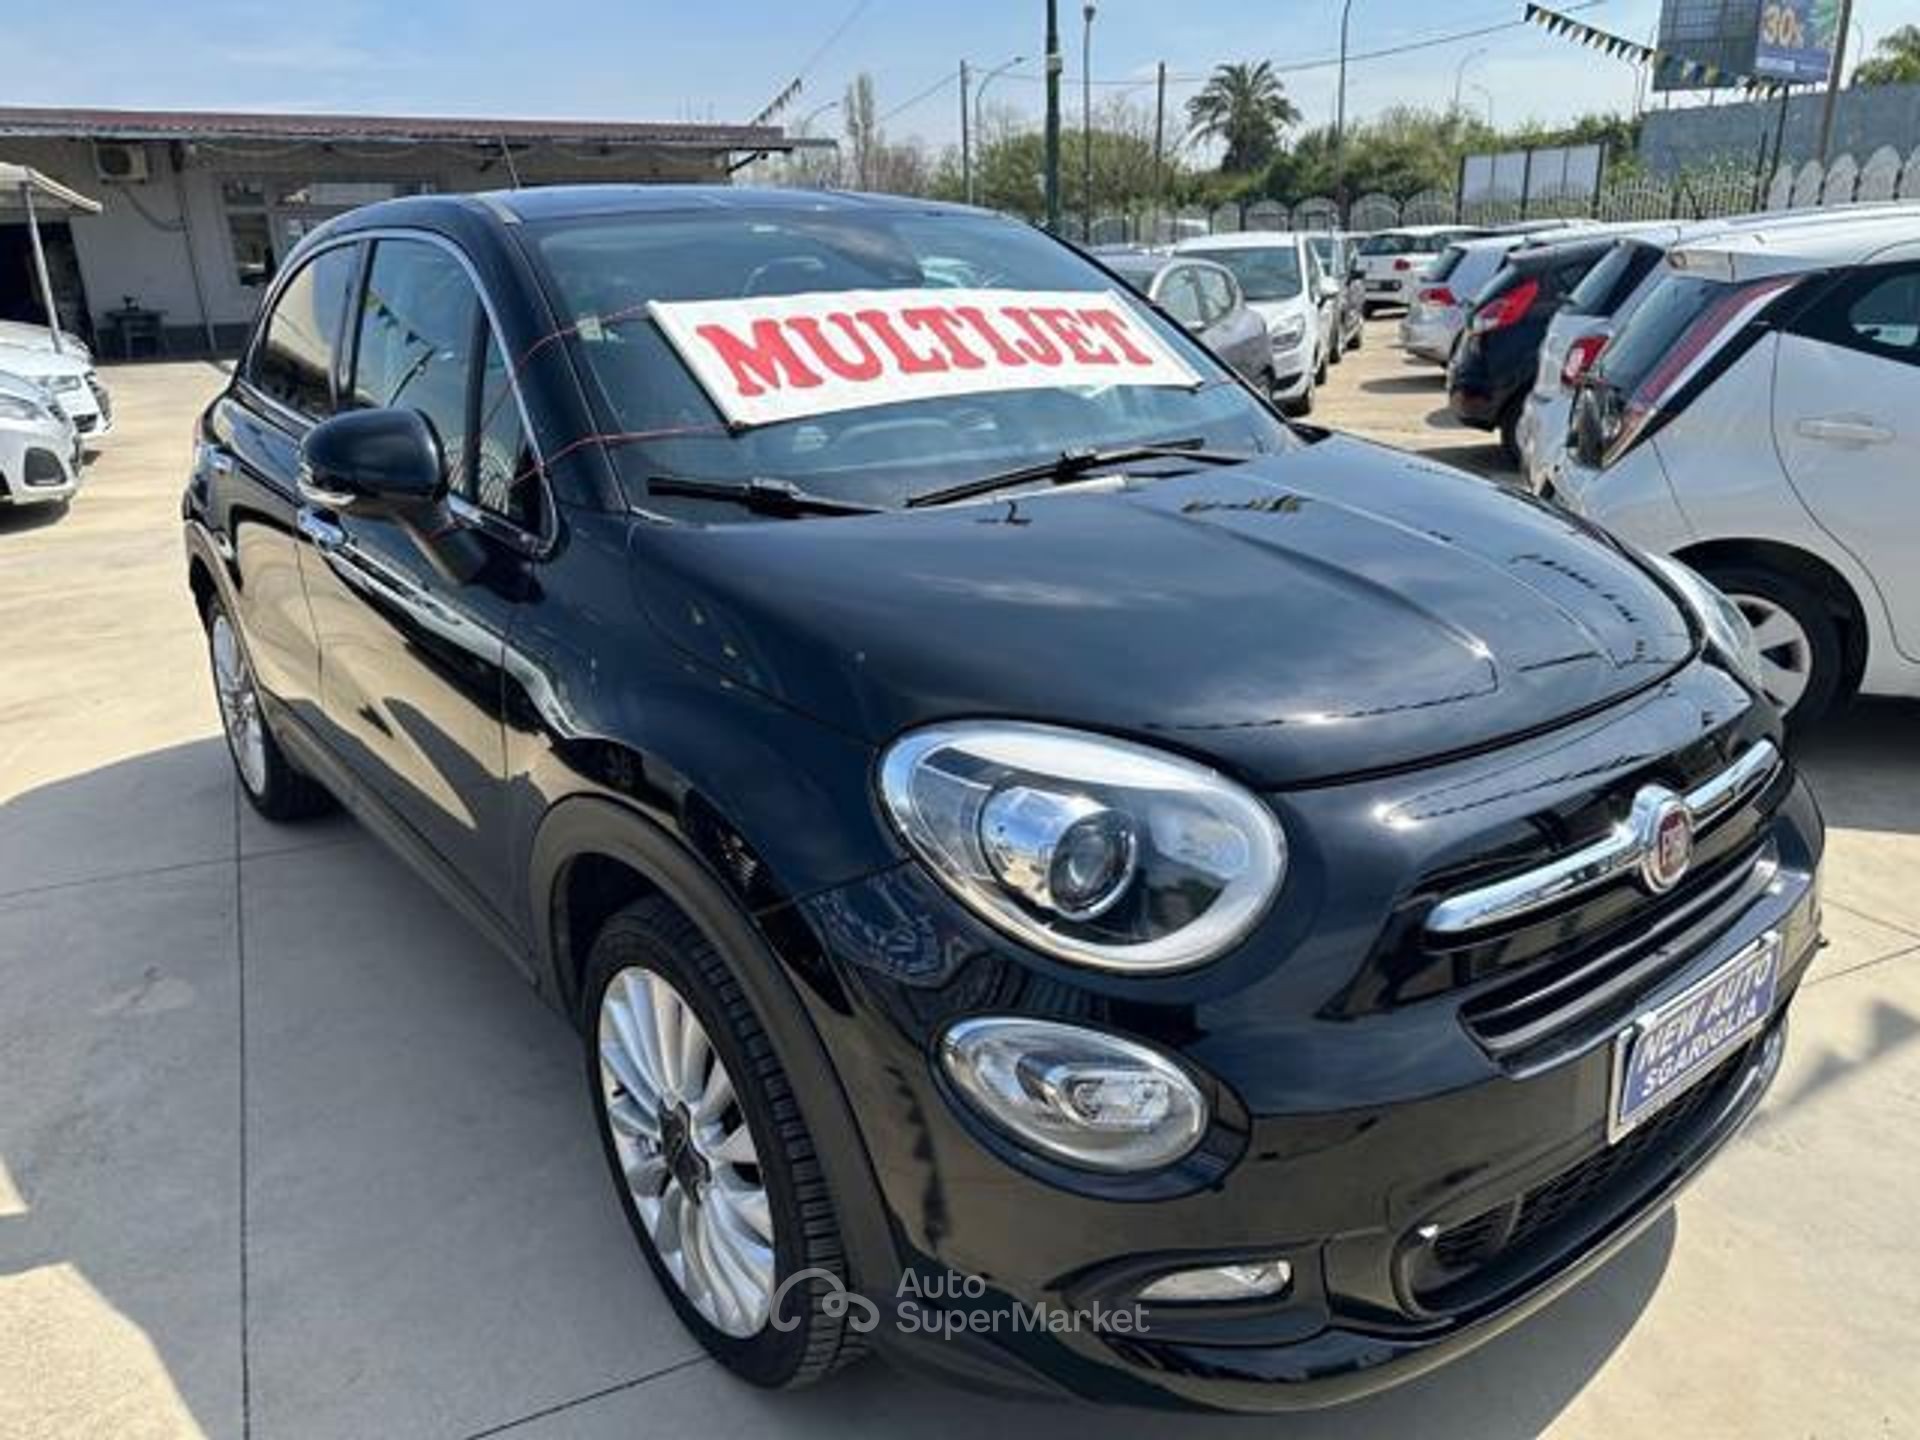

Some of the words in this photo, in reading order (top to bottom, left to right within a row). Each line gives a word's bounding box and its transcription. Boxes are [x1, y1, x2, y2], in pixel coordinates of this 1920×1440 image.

[695, 305, 1154, 397] MULTIJET
[1637, 996, 1708, 1073] NEW
[1704, 950, 1772, 1027] AUTO
